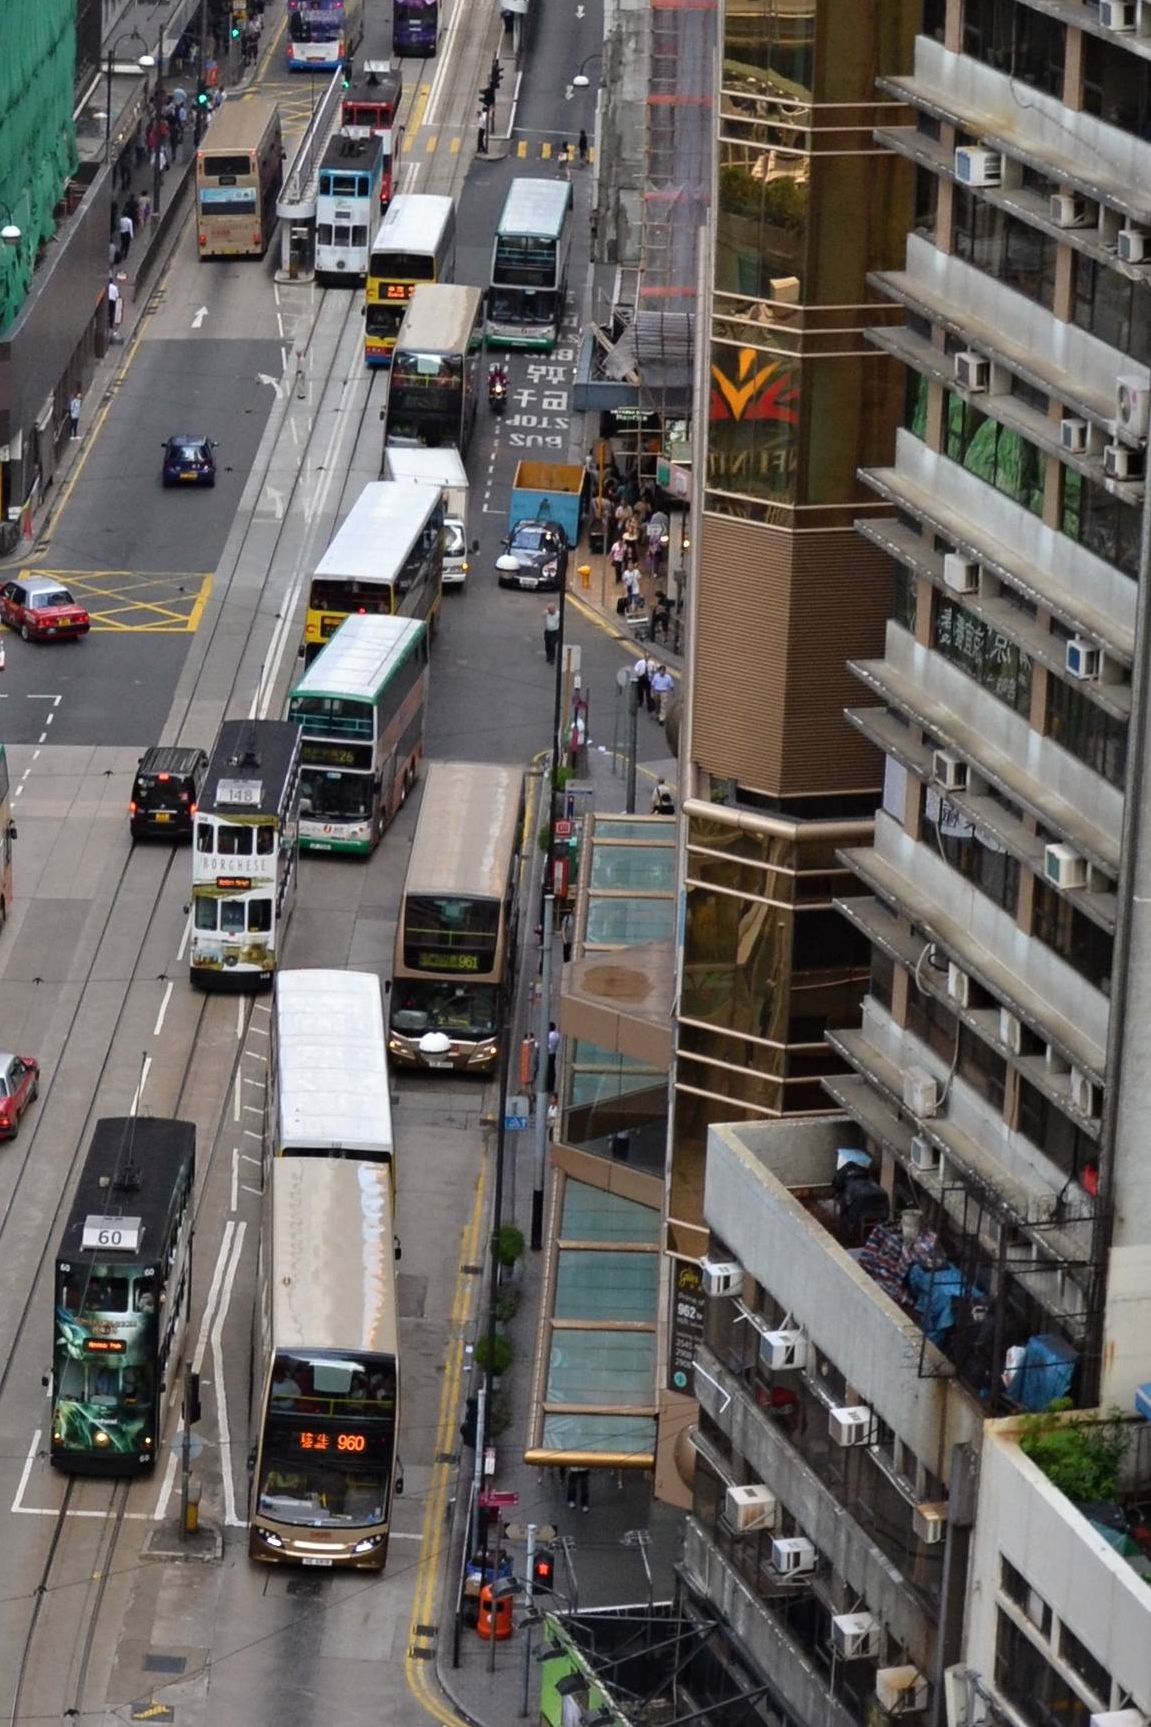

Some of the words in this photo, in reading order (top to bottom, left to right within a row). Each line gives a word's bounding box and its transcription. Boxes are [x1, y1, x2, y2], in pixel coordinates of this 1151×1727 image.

[505, 413, 571, 430] STOP
[509, 433, 563, 449] BUS
[228, 788, 253, 802] 148
[203, 857, 266, 873] BORGHESE
[458, 955, 478, 970] 961
[98, 1230, 122, 1245] 60
[59, 1263, 70, 1272] 60
[144, 1267, 155, 1276] 60
[337, 1433, 366, 1452] 960
[138, 1454, 150, 1463] 60
